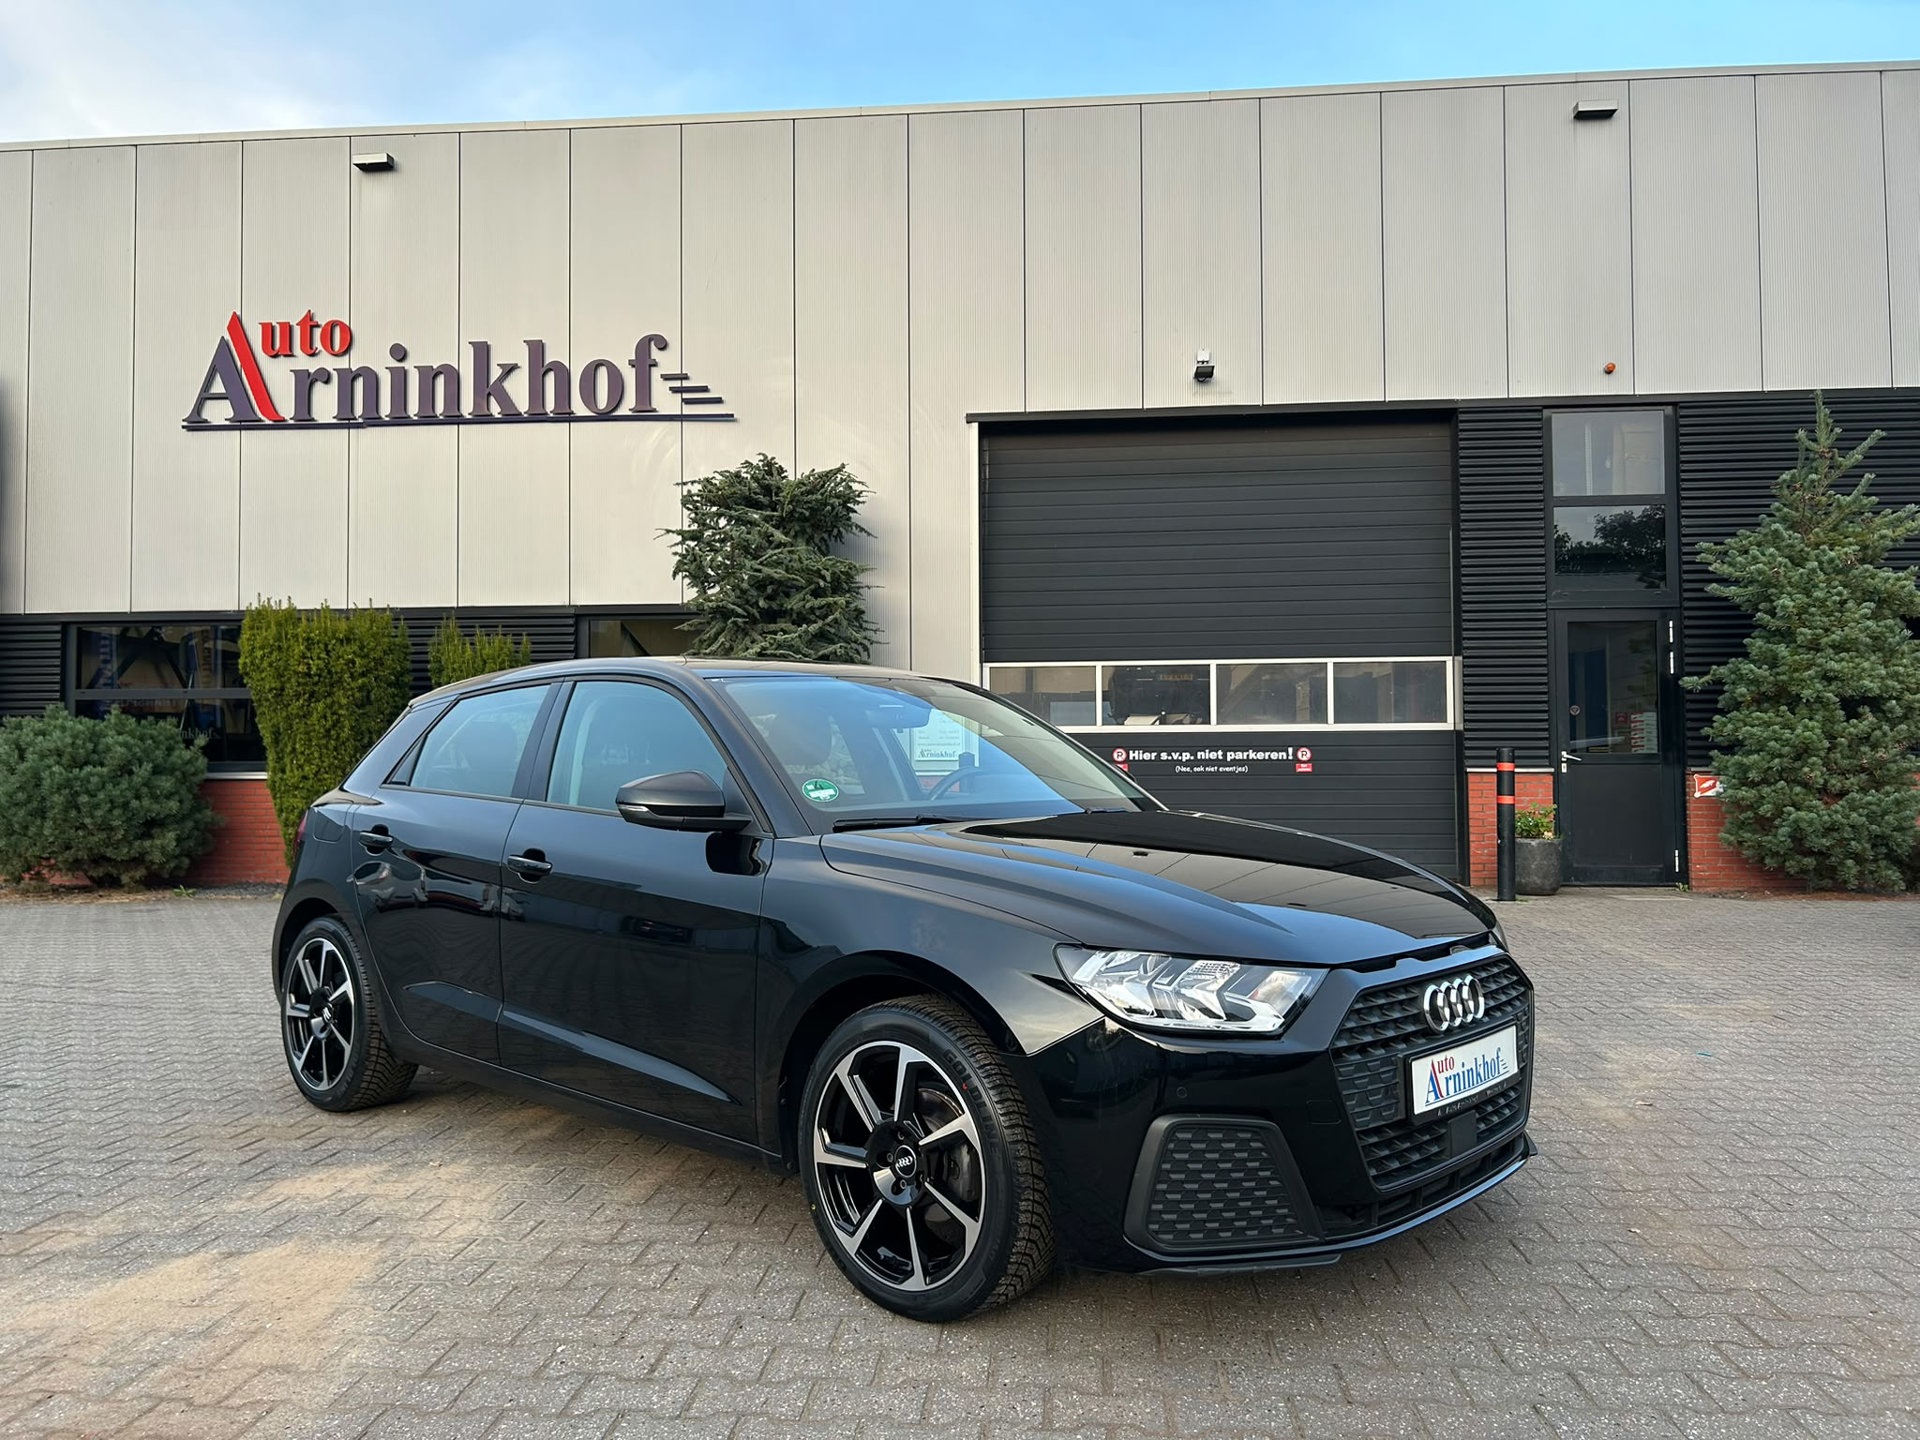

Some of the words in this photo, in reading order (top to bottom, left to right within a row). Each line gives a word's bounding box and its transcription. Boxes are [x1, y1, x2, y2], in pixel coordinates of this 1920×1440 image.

[182, 333, 668, 423] Arninkhof
[1129, 750, 1156, 760] Hier
[1160, 751, 1194, 762] s.v.p.
[1197, 749, 1223, 760] niet
[1227, 747, 1293, 762] parkeren!
[1175, 765, 1193, 773] (Nee,
[1219, 765, 1248, 773] eventjes)
[1425, 1047, 1501, 1104] Arninkhof
